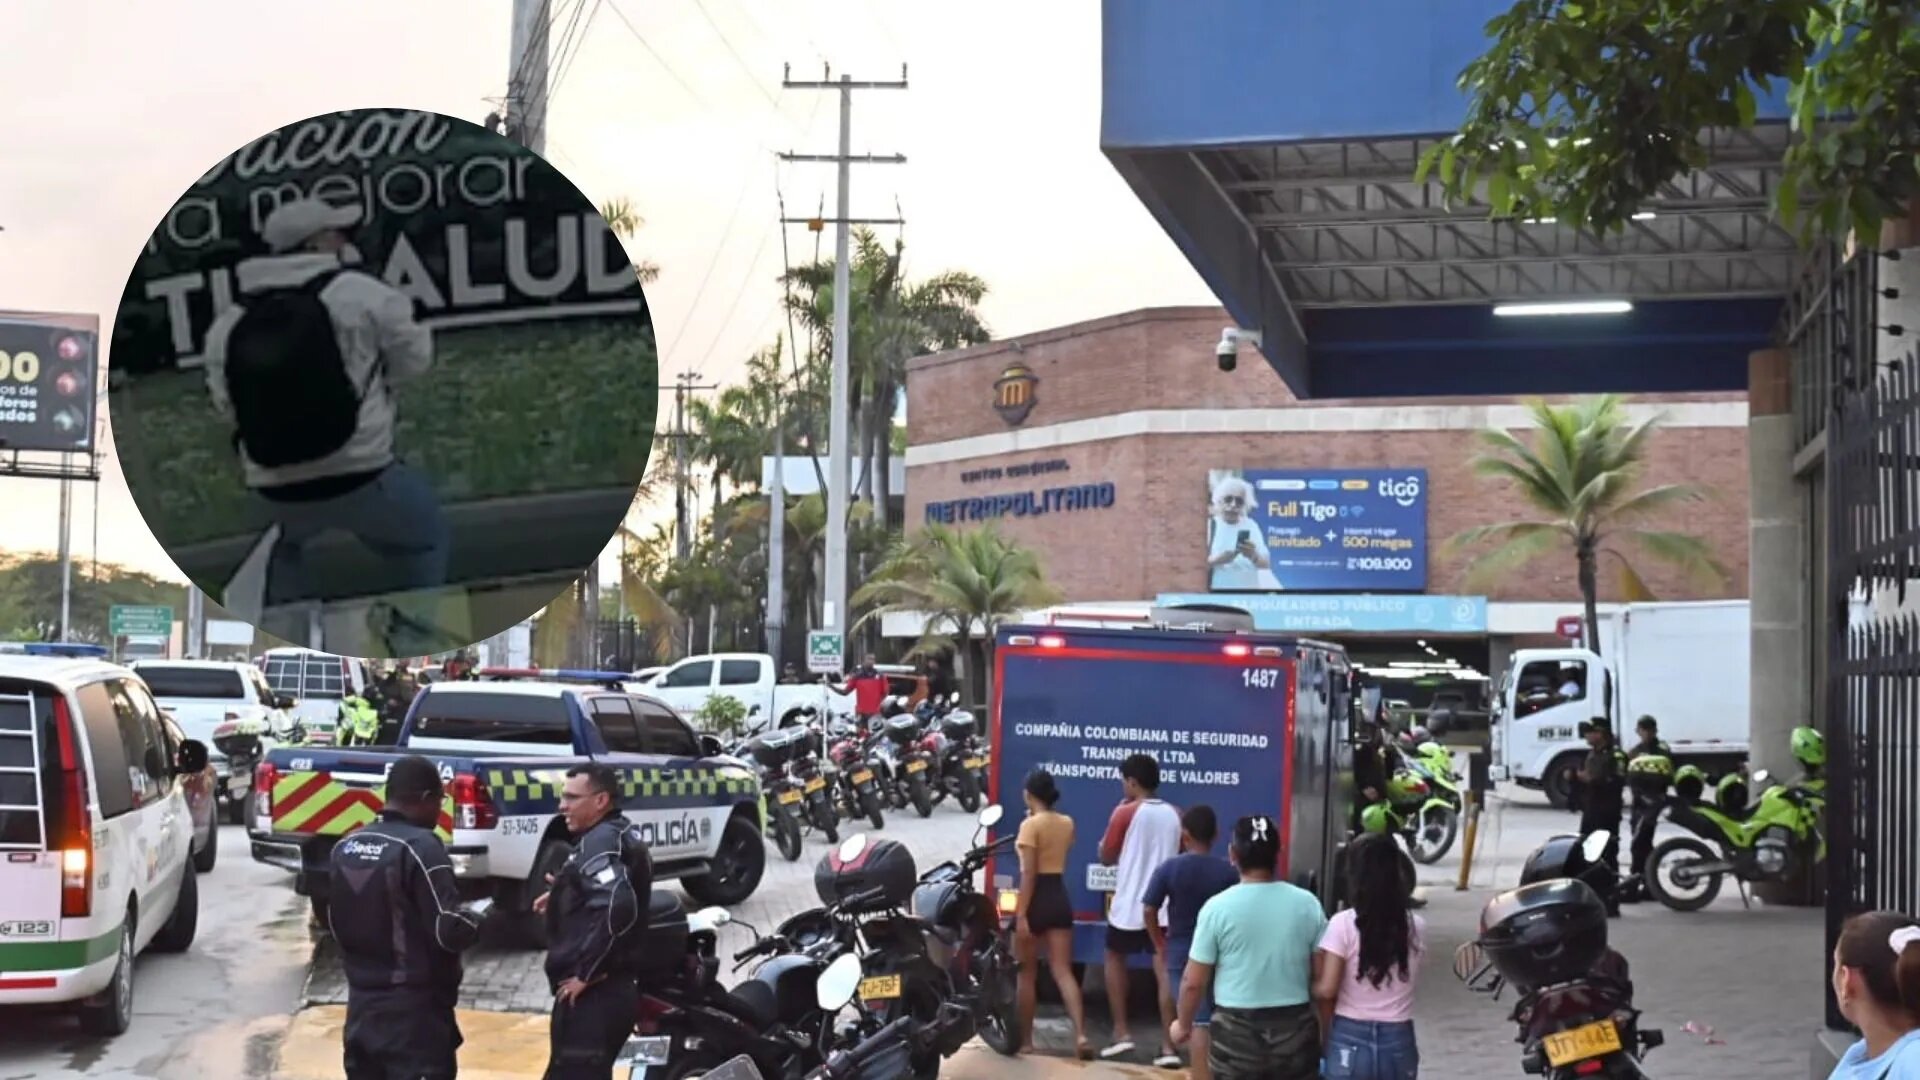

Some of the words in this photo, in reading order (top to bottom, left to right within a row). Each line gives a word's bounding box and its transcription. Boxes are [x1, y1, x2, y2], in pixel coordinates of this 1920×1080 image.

[381, 213, 640, 309] ALUD
[20, 385, 37, 396] de
[1267, 501, 1297, 517] Full
[1300, 500, 1337, 522] Tigo
[1342, 537, 1368, 548] 500
[1370, 538, 1413, 551] megas
[1241, 668, 1278, 689] 1487
[1084, 726, 1169, 744] COLOMBIANA
[1172, 731, 1189, 744] DE
[1192, 733, 1268, 748] SEGURIDAD
[1163, 751, 1195, 764] LTDA
[1159, 771, 1177, 782] DE
[1181, 771, 1240, 786] VALORES
[17, 923, 49, 934] 123
